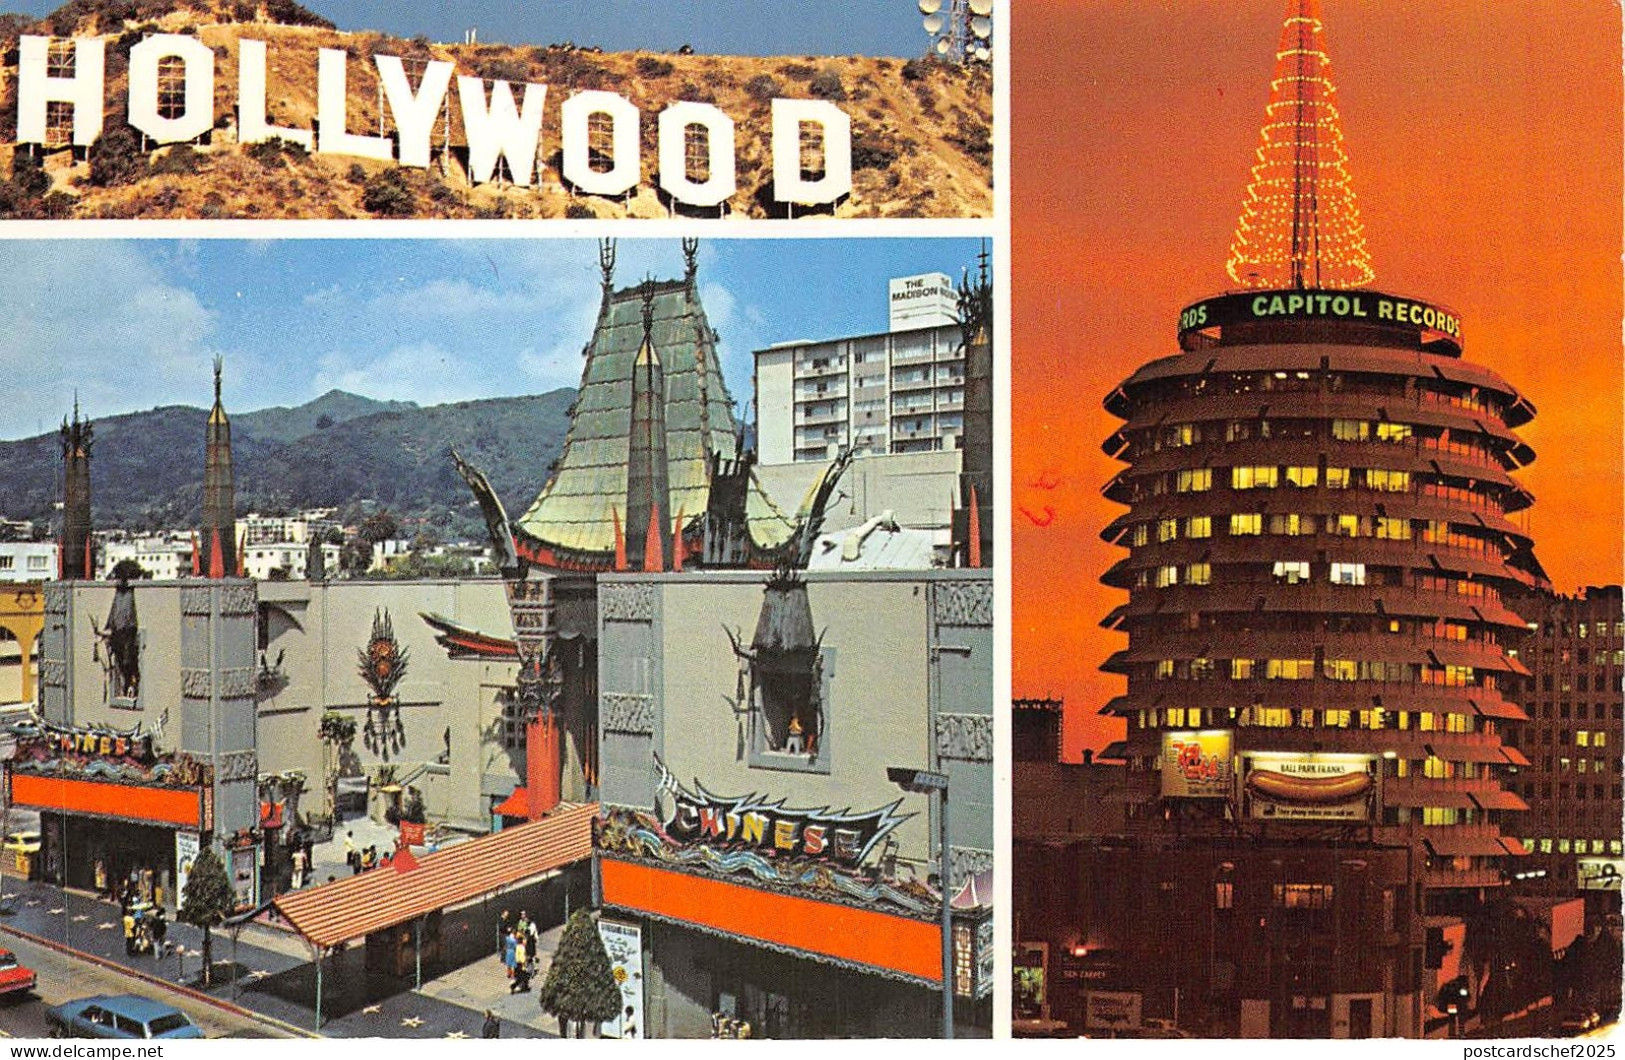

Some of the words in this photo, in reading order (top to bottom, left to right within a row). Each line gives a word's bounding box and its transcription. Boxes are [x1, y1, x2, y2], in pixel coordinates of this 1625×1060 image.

[17, 32, 852, 207] HOLLYWOOD
[891, 286, 939, 302] MADISON
[904, 278, 924, 289] THE
[1178, 304, 1208, 333] RDS
[1252, 295, 1367, 318] CAPITOL
[1378, 300, 1461, 338] RECORDS
[1280, 763, 1296, 773] BALL
[1297, 763, 1317, 774] PARK
[674, 801, 863, 860] CHINESE
